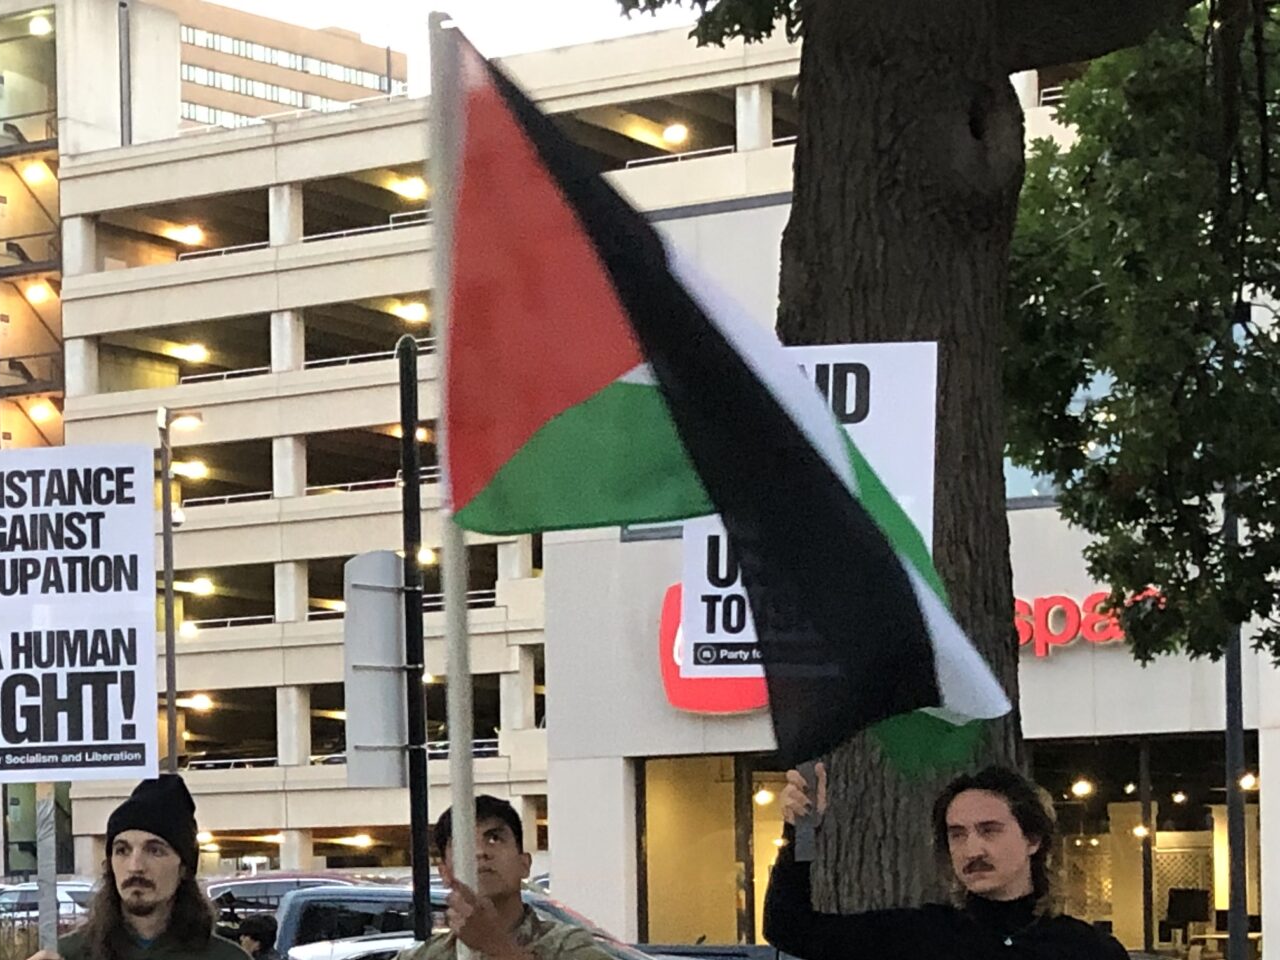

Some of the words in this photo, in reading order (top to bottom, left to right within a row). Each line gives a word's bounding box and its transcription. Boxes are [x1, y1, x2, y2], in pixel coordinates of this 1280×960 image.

[701, 594, 746, 634] TO
[11, 628, 137, 668] HUMAN
[720, 649, 749, 661] Party
[5, 752, 58, 764] Socialism
[61, 751, 81, 762] and
[85, 750, 142, 761] Liberation
